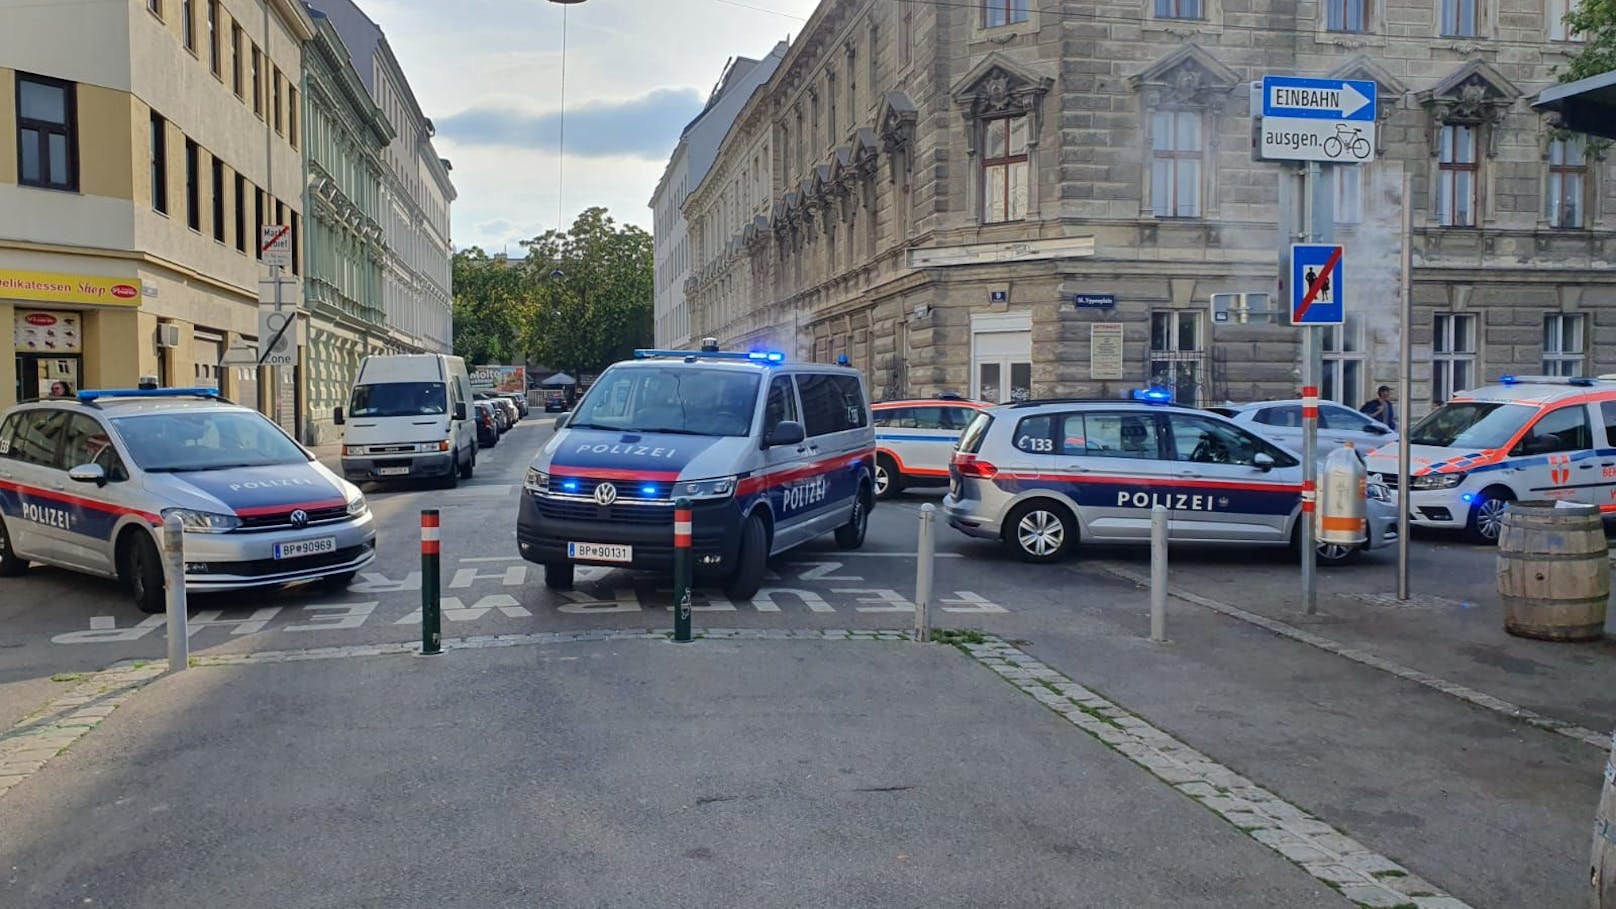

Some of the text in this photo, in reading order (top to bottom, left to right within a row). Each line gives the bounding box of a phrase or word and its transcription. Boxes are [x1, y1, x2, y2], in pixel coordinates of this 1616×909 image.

[1275, 88, 1340, 108] EINBAHN
[1266, 130, 1323, 149] ausgen.
[0, 279, 72, 293] elikatessen
[77, 281, 106, 297] Shop
[577, 444, 677, 459] POLIZEI
[1029, 438, 1053, 452] 133
[229, 477, 312, 493] POLIZEI
[782, 477, 827, 513] POLIZEI
[1117, 491, 1214, 512] POLIZEI
[22, 502, 71, 530] POLIZEI
[282, 539, 333, 556] BP 90969
[578, 545, 627, 559] BP 90131
